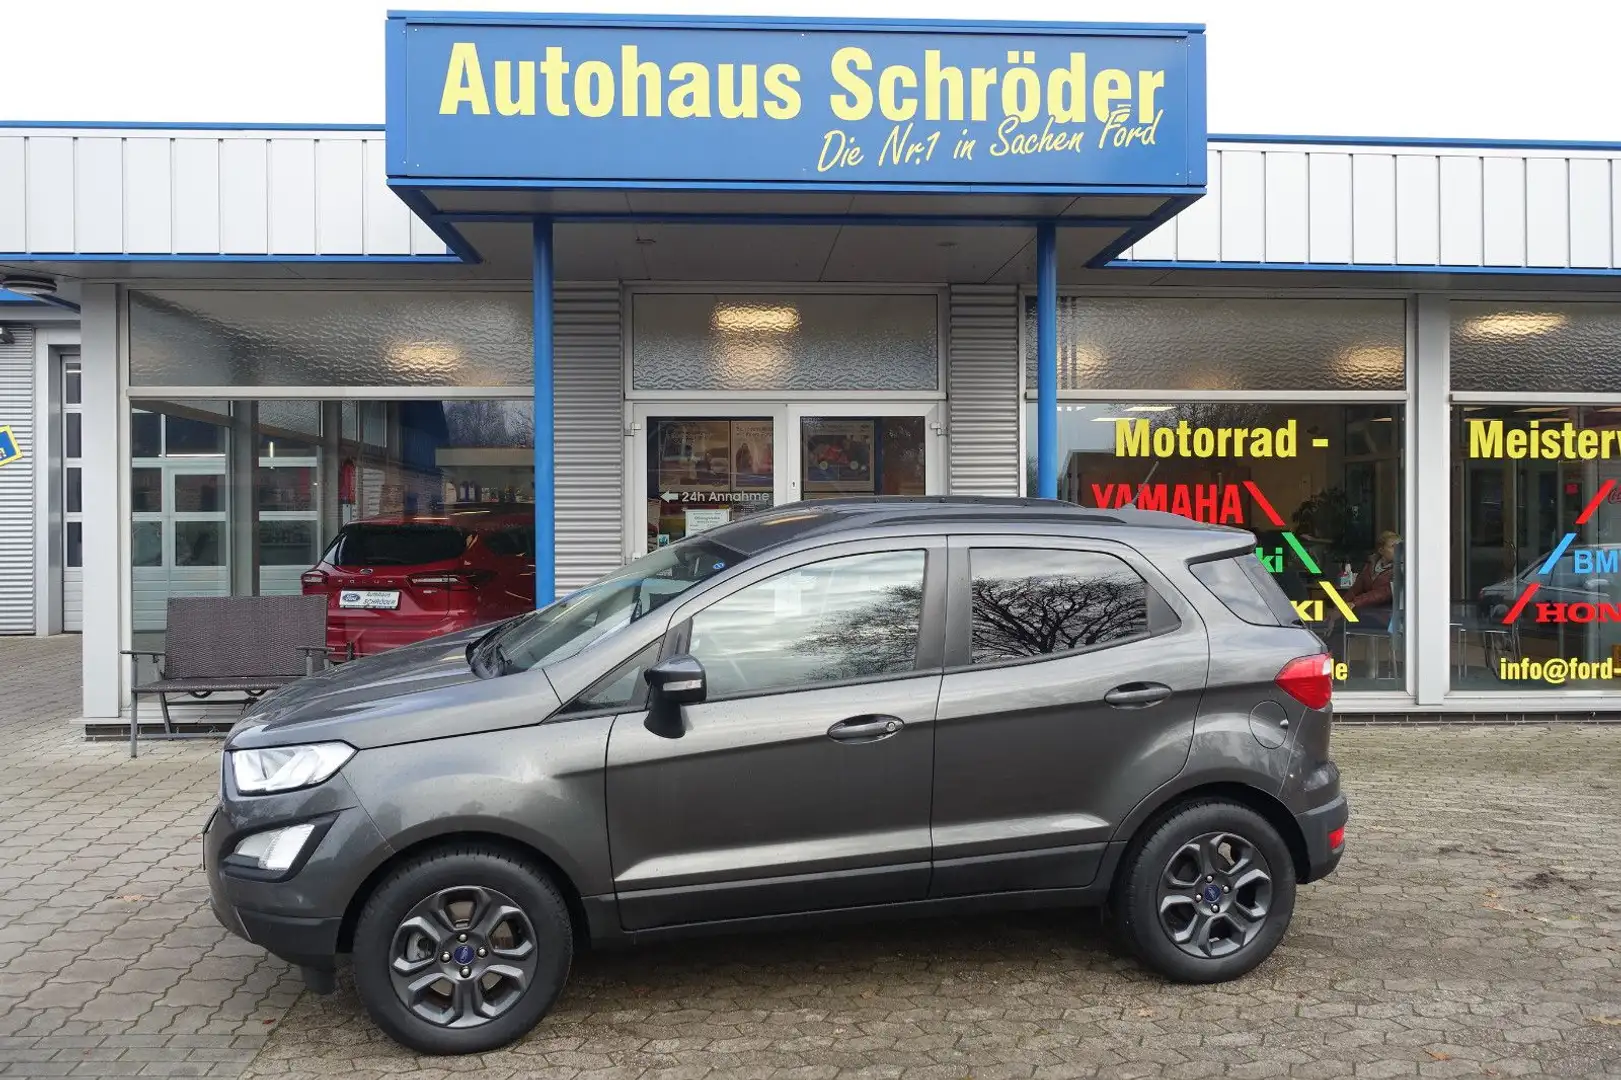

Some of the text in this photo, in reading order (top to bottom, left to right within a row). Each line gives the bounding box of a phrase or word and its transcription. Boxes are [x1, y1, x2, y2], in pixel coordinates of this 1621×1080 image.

[439, 42, 1165, 124] Autohaus Schröder
[817, 107, 1164, 172] Die Nr.1 in Sachen Ford
[1115, 418, 1297, 459] Motorrad
[681, 490, 770, 502] 24h Annahme
[1092, 483, 1244, 524] YAMAHA
[1574, 550, 1621, 574] BM
